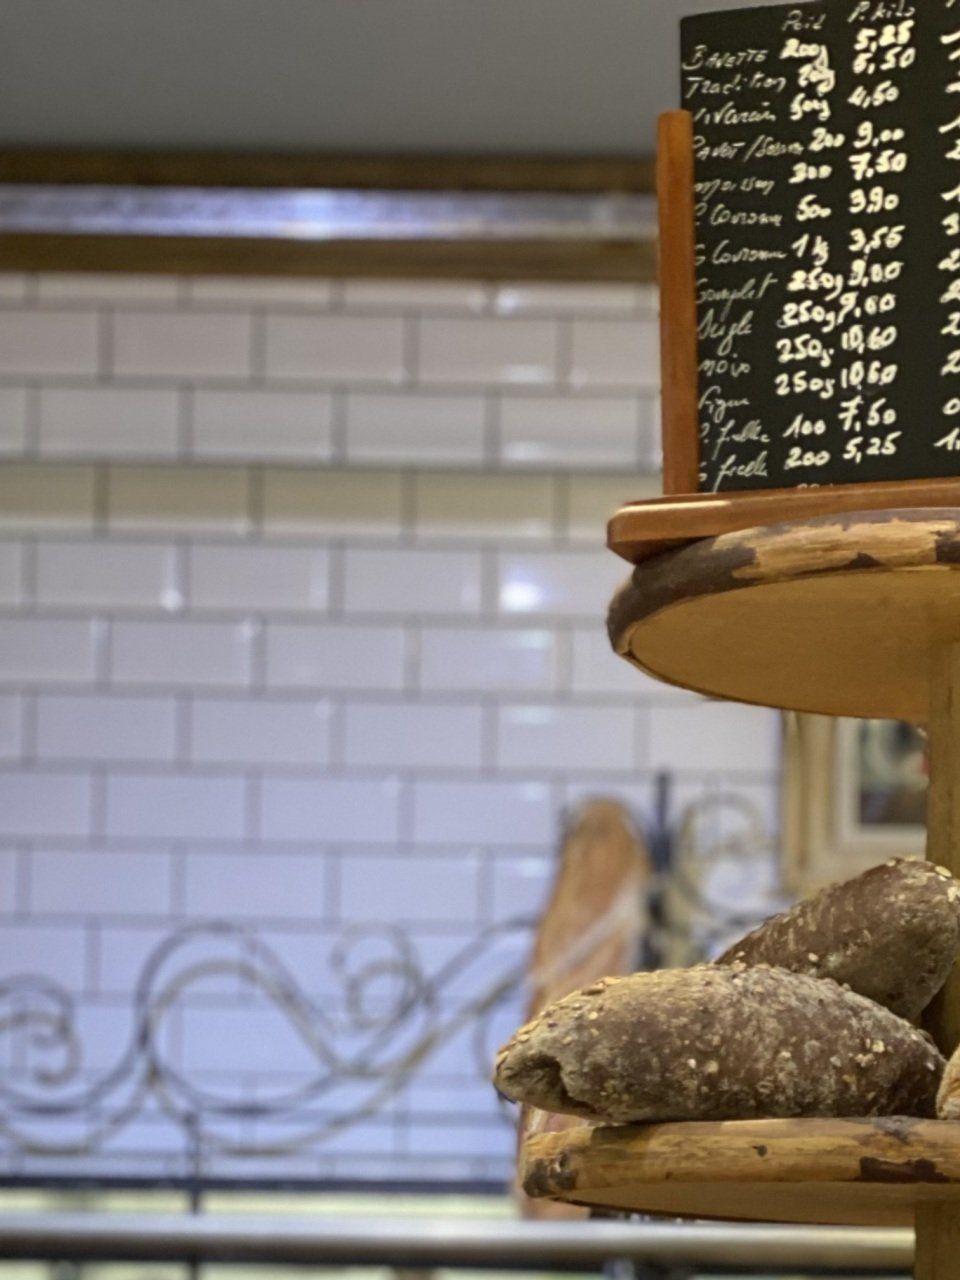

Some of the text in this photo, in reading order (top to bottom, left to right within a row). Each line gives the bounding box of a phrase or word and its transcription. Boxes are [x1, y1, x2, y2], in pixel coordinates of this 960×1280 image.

[847, 80, 899, 109] 4,50
[809, 127, 846, 151] 200
[853, 121, 905, 148] 9,00
[788, 162, 833, 184] 300
[848, 149, 907, 181] 7,50
[796, 194, 832, 221] 500
[848, 186, 899, 213] 3,90
[848, 225, 905, 257] 3,55
[786, 266, 844, 302] 250g
[777, 299, 836, 333] 250g
[841, 325, 897, 354] 10,60
[773, 370, 836, 399] 250g
[782, 412, 827, 439] 100
[837, 395, 898, 432] 7,50
[783, 446, 831, 470] 200
[842, 431, 903, 463] 5,25
